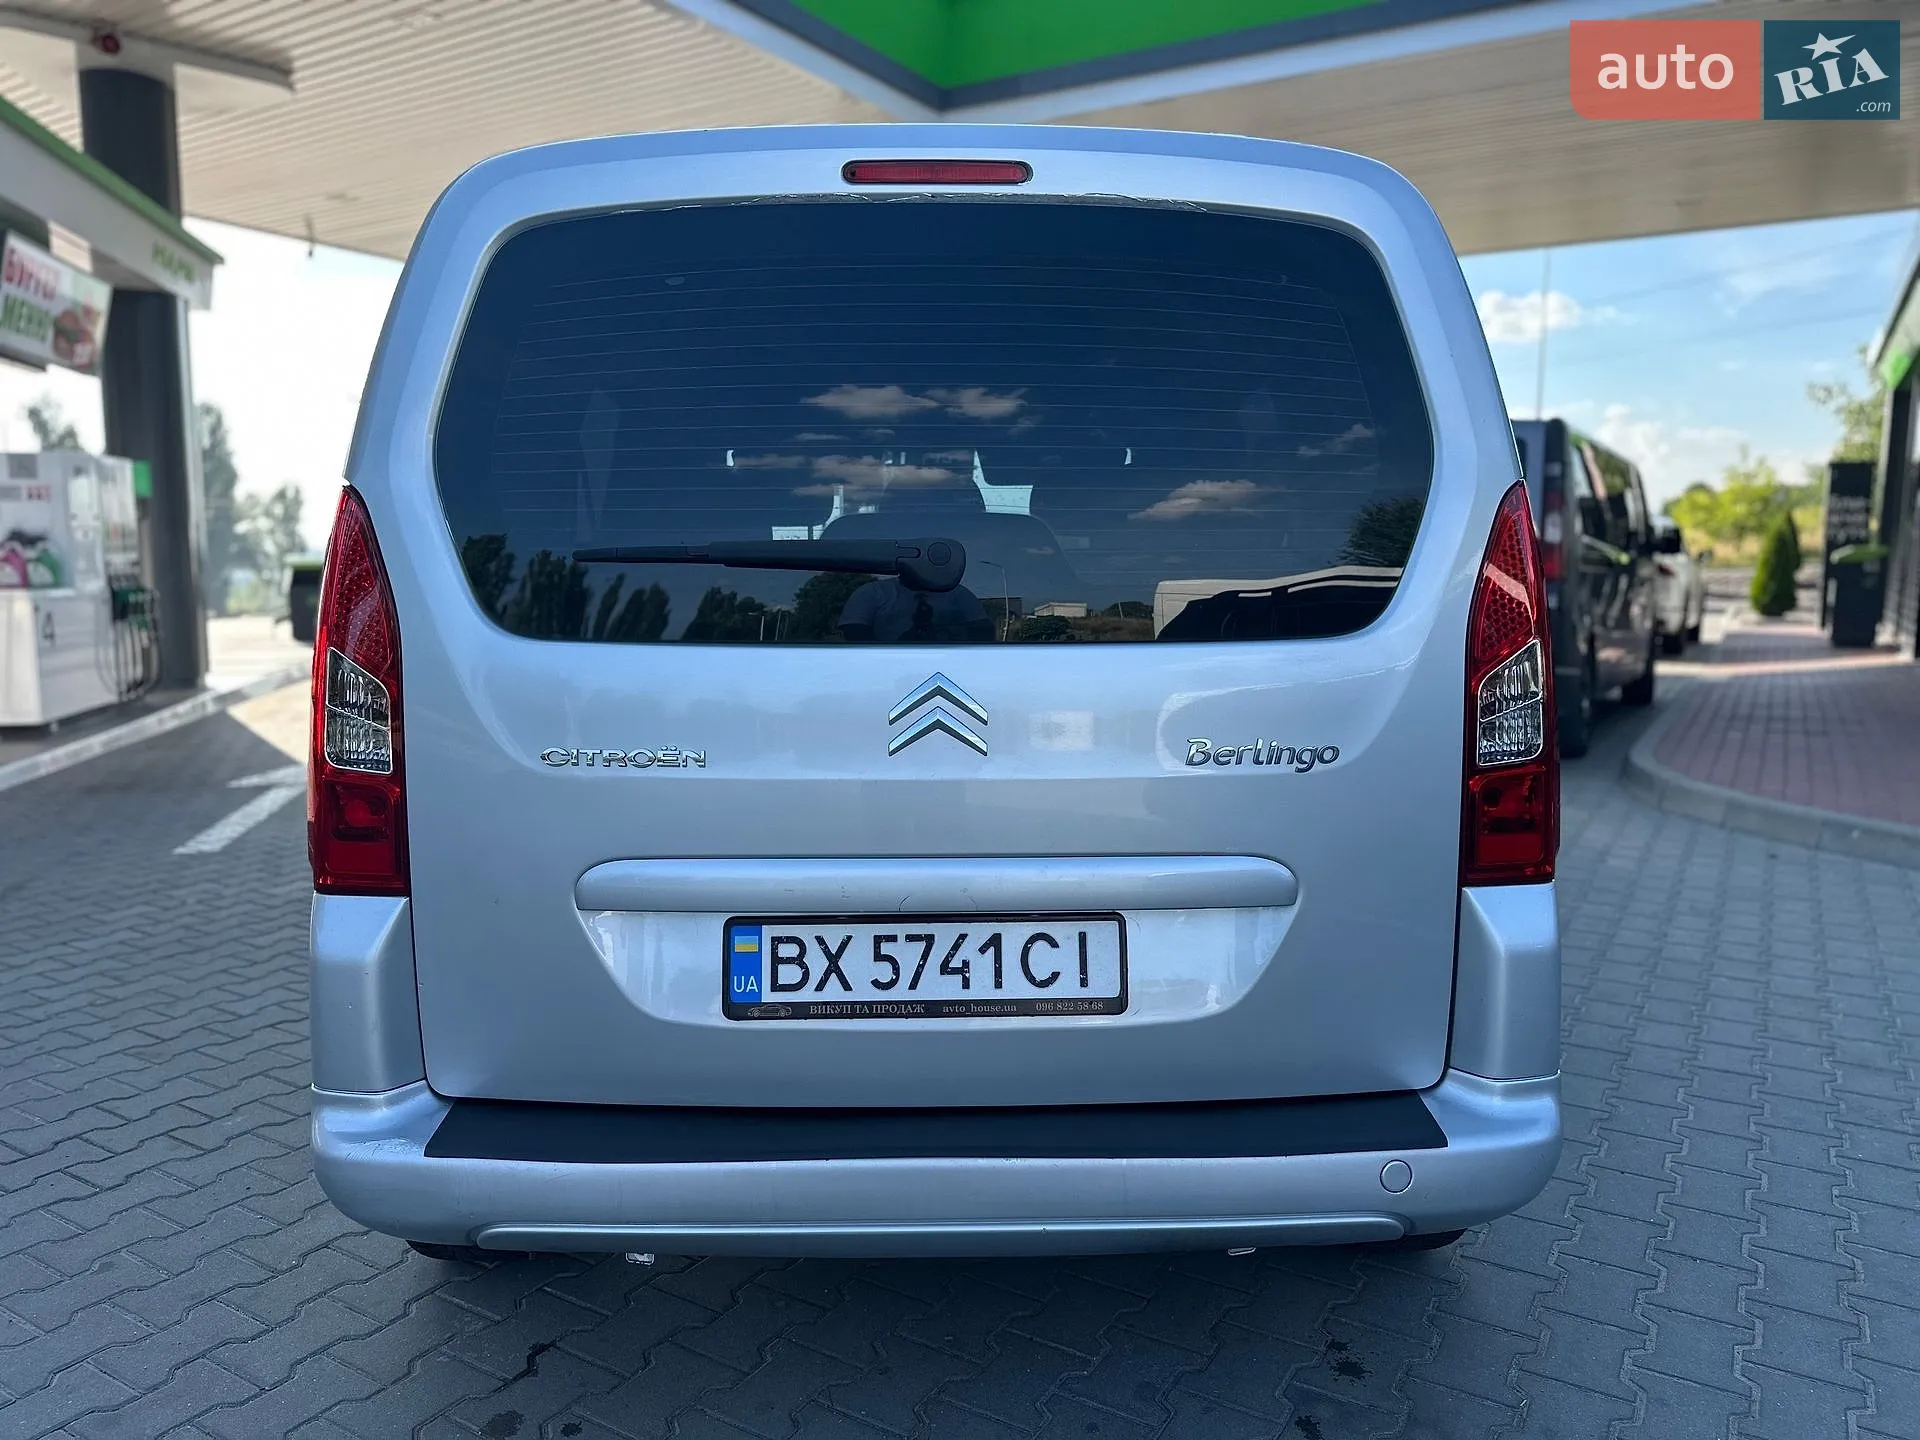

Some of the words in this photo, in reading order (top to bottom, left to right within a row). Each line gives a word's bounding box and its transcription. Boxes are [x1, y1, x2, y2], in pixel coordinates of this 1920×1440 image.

[540, 745, 707, 768] CITROËN
[1185, 738, 1340, 773] Berlingo
[770, 935, 853, 992] BX
[870, 932, 1002, 991] 5741
[1020, 931, 1088, 988] CI
[733, 975, 758, 993] UA
[810, 1005, 854, 1014] ВИКУП
[855, 1005, 869, 1014] ТА
[872, 1004, 924, 1015] ПРОДАЖ
[1036, 1002, 1053, 1011] 096
[1056, 1002, 1074, 1011] 822
[1077, 1001, 1089, 1010] 58
[1091, 1001, 1104, 1010] 68
